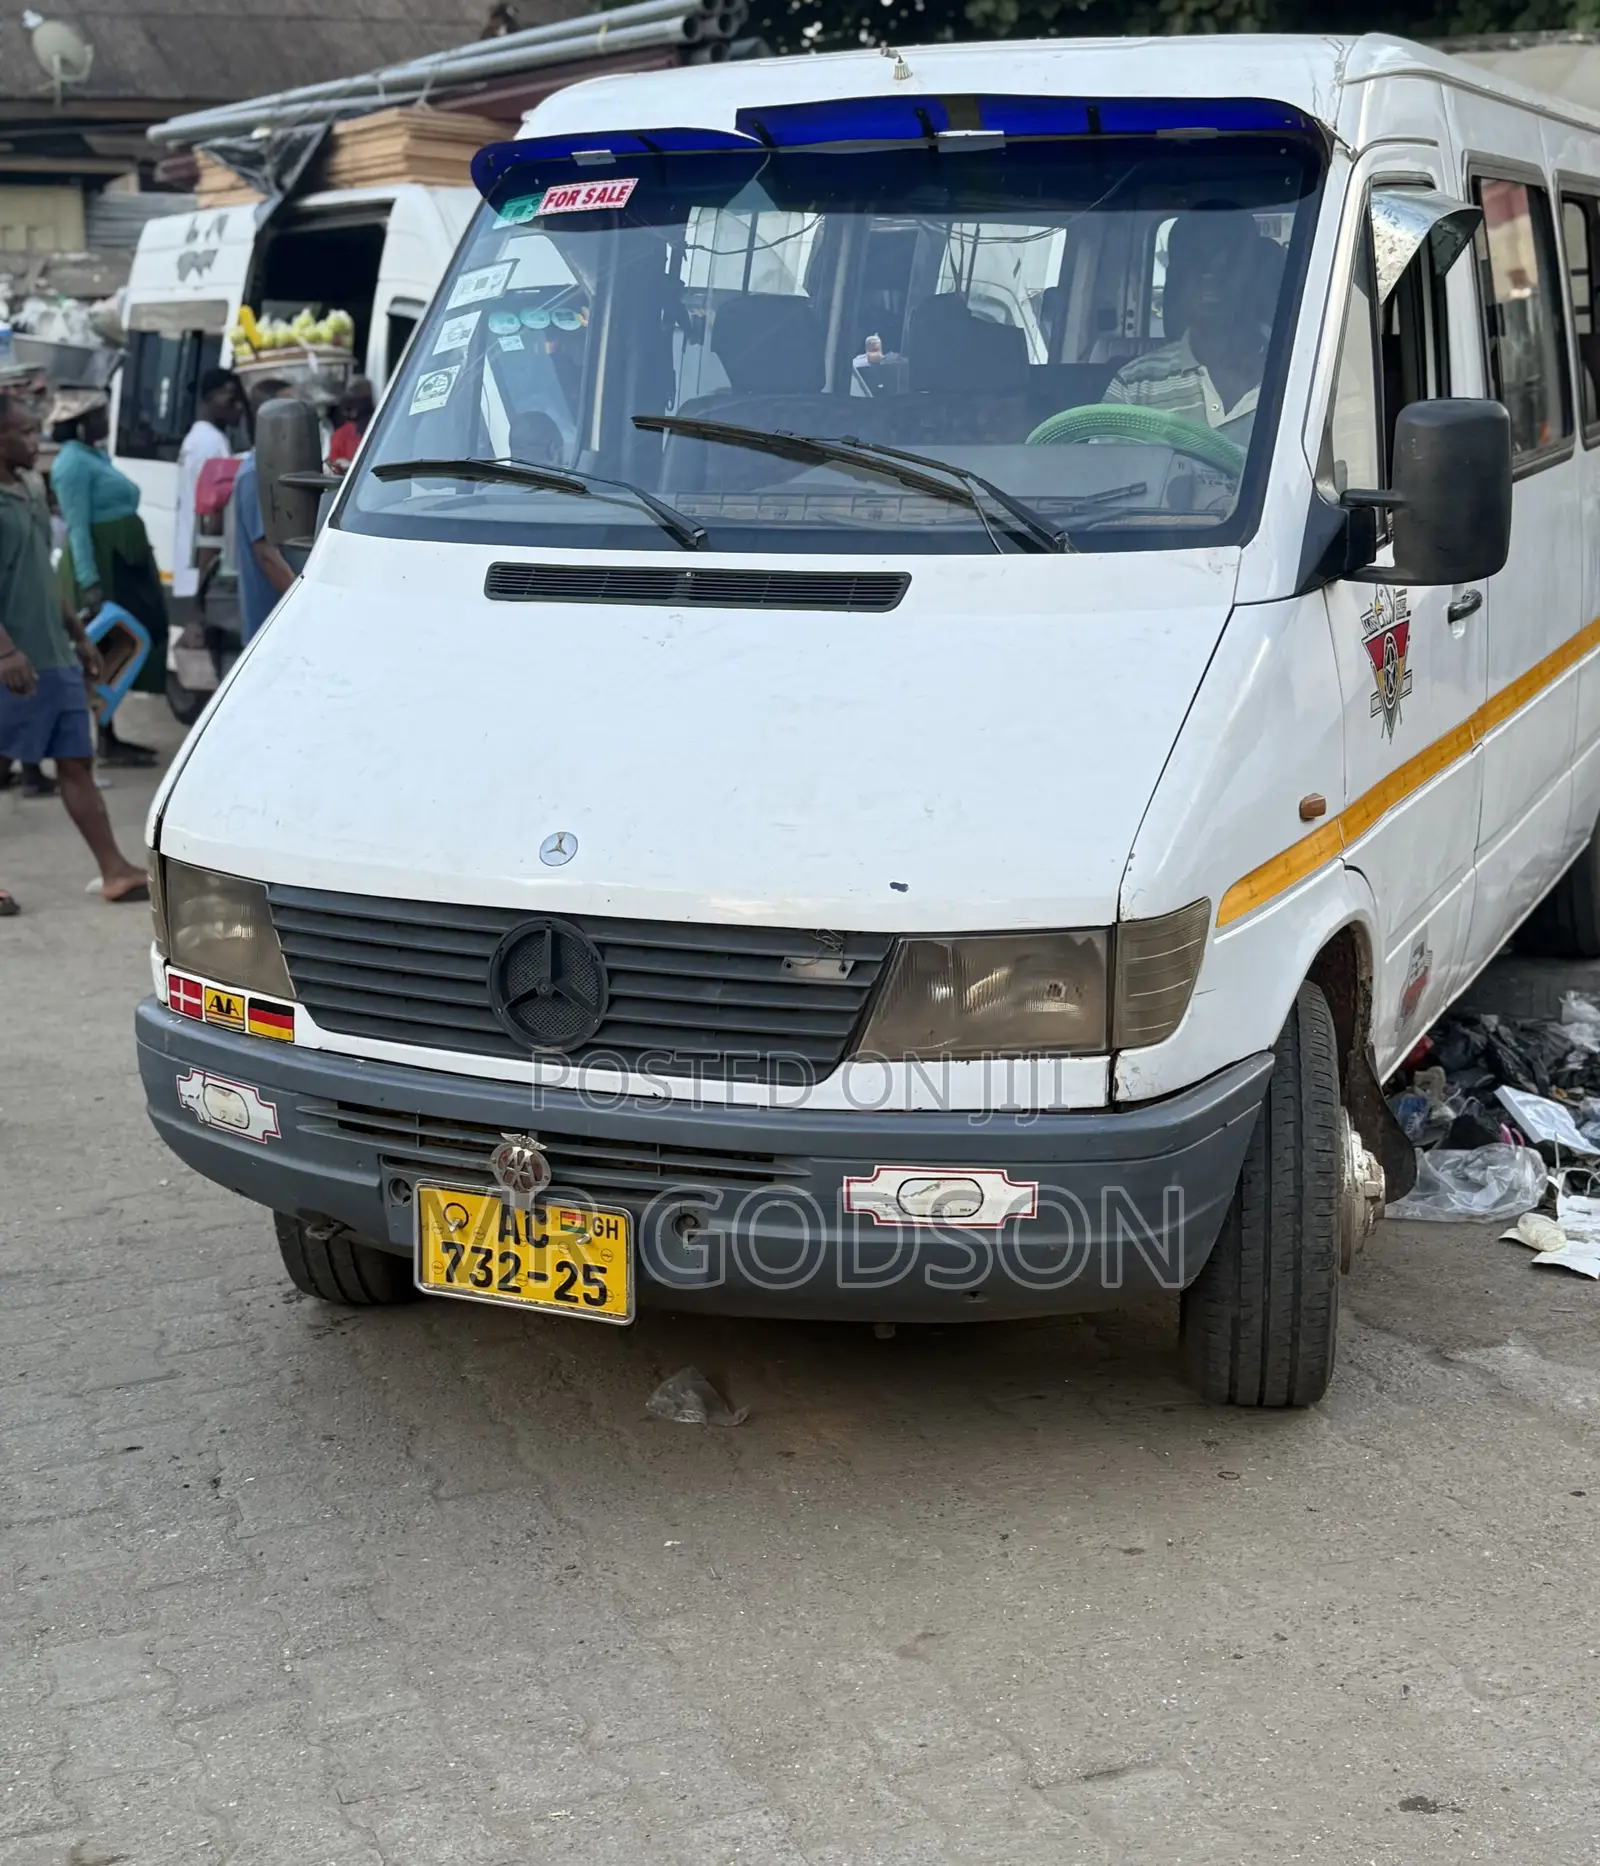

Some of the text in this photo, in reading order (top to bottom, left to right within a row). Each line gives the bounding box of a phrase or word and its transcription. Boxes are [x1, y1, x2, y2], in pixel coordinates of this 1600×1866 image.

[544, 190, 581, 209] FOR
[582, 185, 629, 204] SALE
[209, 995, 239, 1016] AA
[498, 1203, 619, 1248] AC GH
[441, 1241, 607, 1306] 732-25
